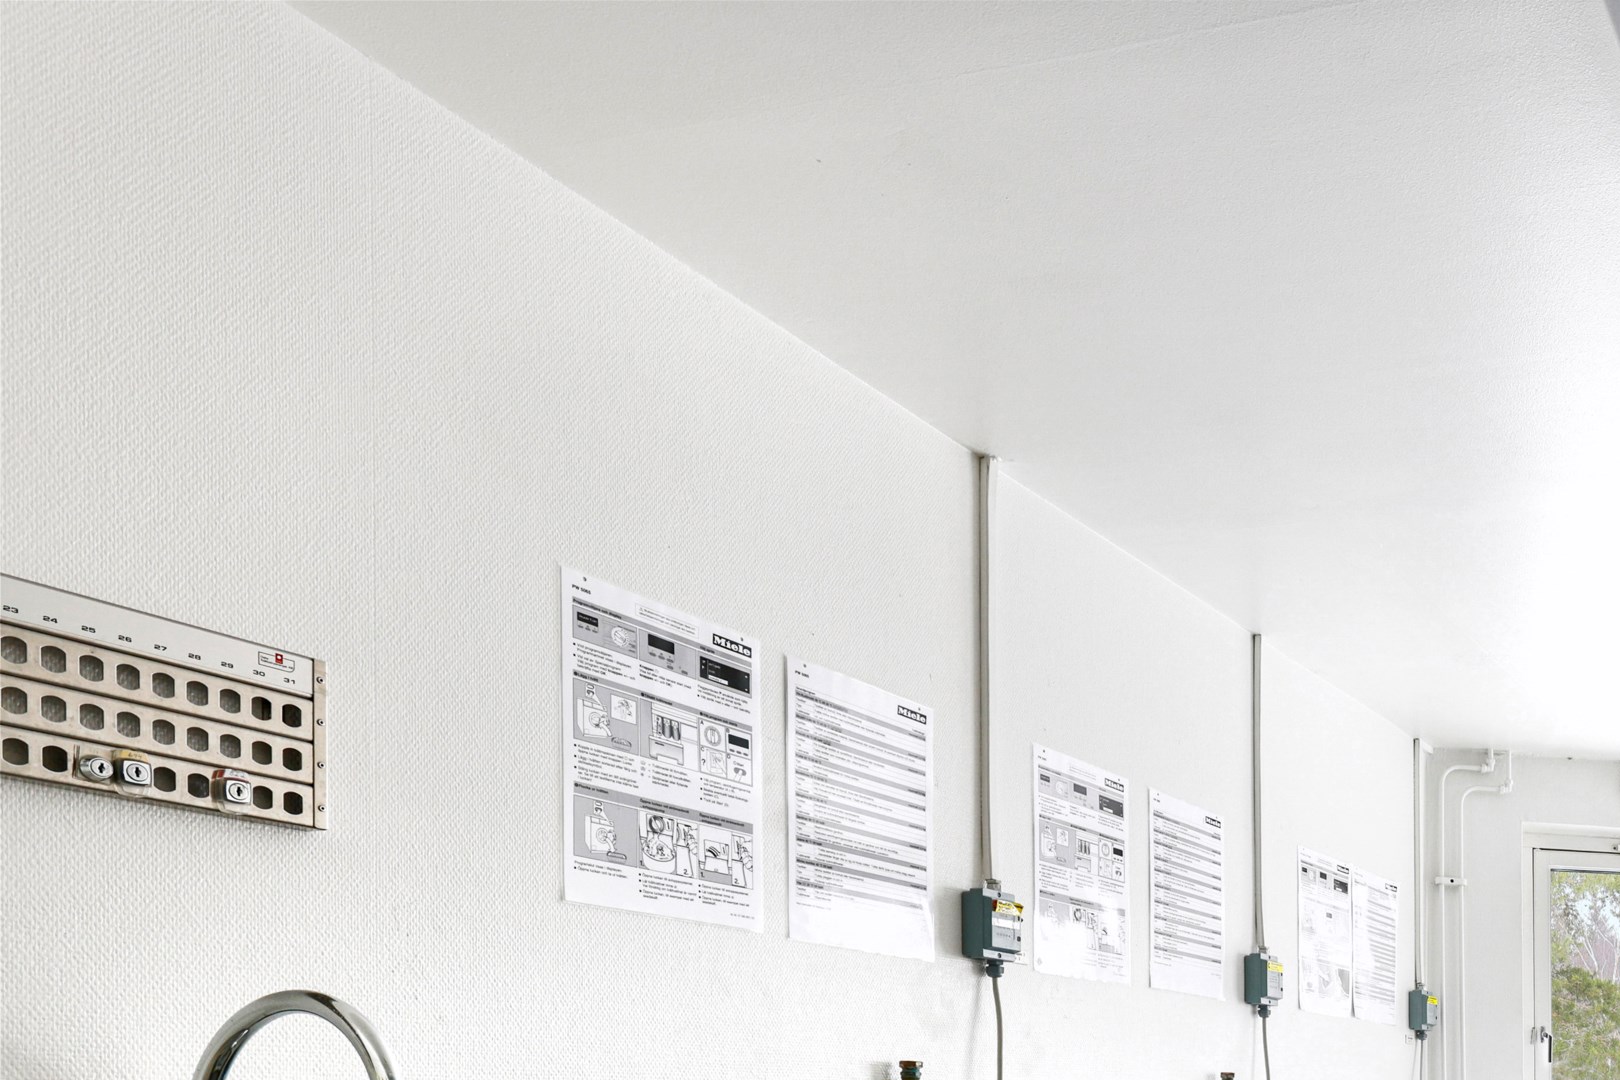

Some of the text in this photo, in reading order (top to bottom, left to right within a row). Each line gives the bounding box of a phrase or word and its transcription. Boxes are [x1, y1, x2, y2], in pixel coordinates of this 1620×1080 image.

[2, 604, 19, 614] 23
[42, 616, 58, 624] 24
[82, 625, 96, 634] 25
[118, 634, 132, 642] 26
[188, 652, 202, 660] 28
[714, 635, 751, 658] Miele
[898, 706, 926, 723] Miele
